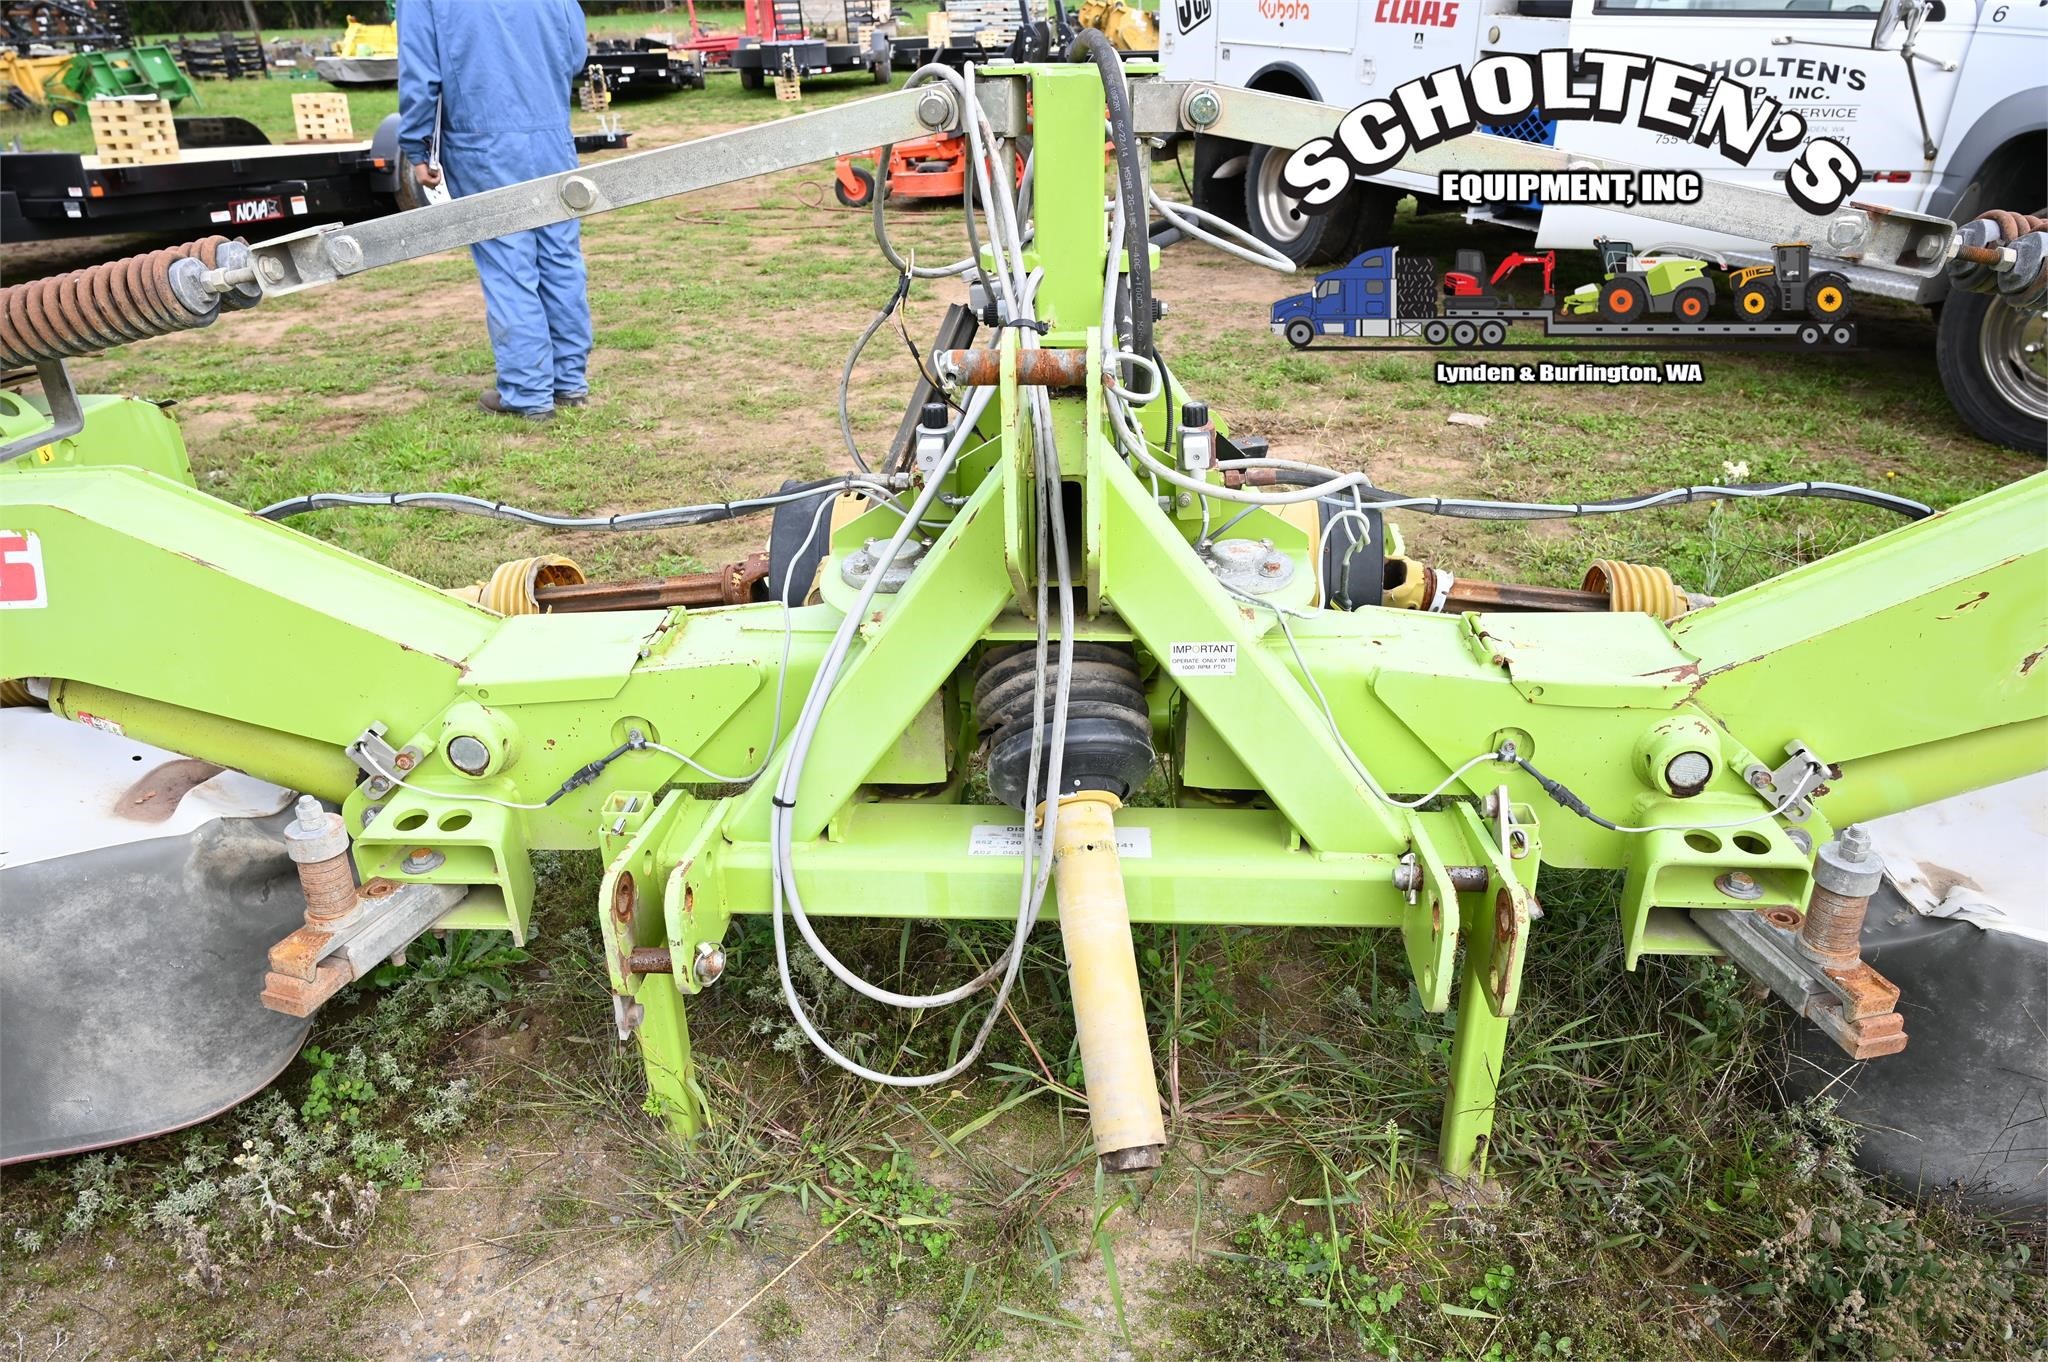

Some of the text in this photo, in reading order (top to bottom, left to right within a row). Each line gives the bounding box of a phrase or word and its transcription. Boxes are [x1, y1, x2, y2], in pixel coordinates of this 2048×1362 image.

[1375, 0, 1460, 28] CLAAS
[1992, 5, 2009, 23] 6
[1788, 86, 1831, 100] INC.
[1790, 107, 1858, 119] ERVICE
[236, 200, 268, 222] NOVA
[1172, 644, 1236, 654] IMPORTANT
